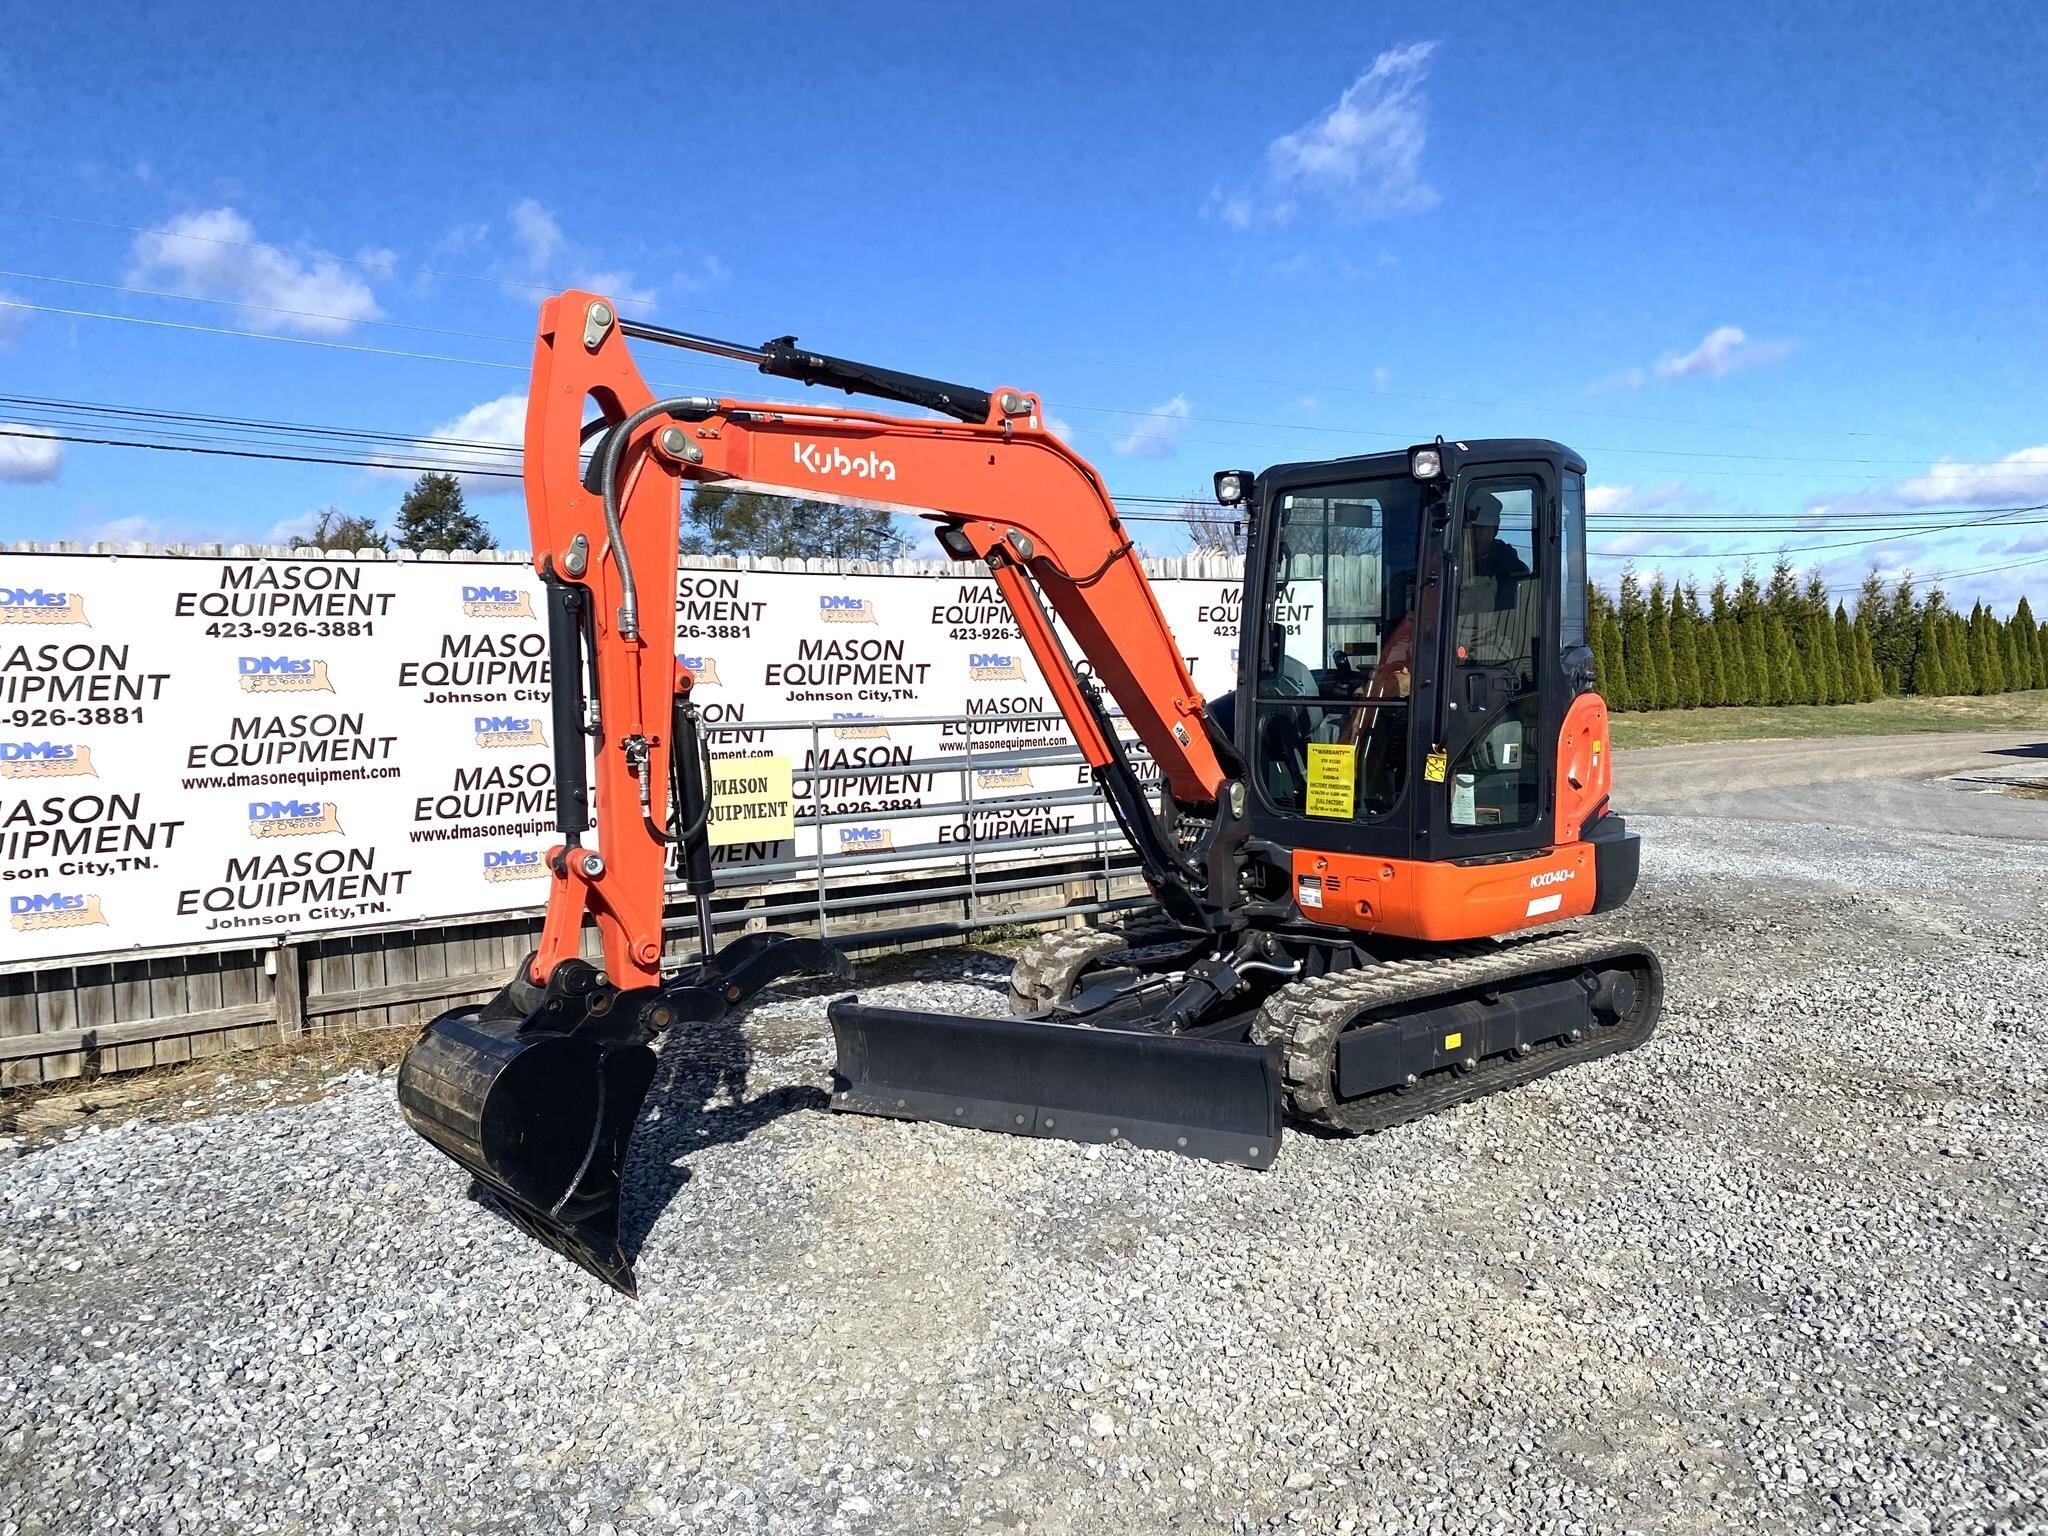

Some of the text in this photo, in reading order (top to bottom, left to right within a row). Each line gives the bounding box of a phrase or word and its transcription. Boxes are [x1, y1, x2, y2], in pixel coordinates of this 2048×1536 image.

[793, 441, 896, 481] Kubota
[220, 566, 360, 590] MASON
[679, 577, 739, 599] SON
[175, 593, 396, 617] EQUIPMENT
[958, 586, 1006, 604] MAS
[676, 601, 767, 622] PMENT
[205, 621, 373, 638] 423-926-3881
[677, 625, 751, 638] 26-3881
[949, 628, 1023, 640] 423-926-3
[440, 633, 550, 658] MASO
[798, 639, 905, 661] MASON
[0, 645, 129, 672] ASON
[399, 660, 552, 687] EQUIPME
[765, 664, 931, 686] EQUIPMENT
[0, 674, 171, 703] IPMENT
[423, 692, 507, 704] Johnson
[785, 690, 853, 702] Johnson
[0, 707, 143, 727] -926-3881
[966, 696, 1043, 715] MASON
[230, 713, 363, 740] MASON
[187, 737, 397, 769] EQUIPMENT
[939, 737, 1067, 752] www.masonequipment.com
[805, 746, 913, 772] MASON
[182, 765, 401, 790] www.dmasonequipment.com
[453, 763, 556, 791] MASO
[713, 777, 768, 796] MASON
[793, 773, 934, 800] QUIPMENT
[0, 793, 140, 828] ASON
[415, 789, 597, 821] EQUIPME
[706, 801, 788, 825] QUIPMENT
[0, 821, 185, 860] IPMENT
[938, 815, 1075, 844] EQUIPMENT
[225, 847, 375, 883] MASON
[176, 870, 412, 916] EQUIPMENT
[205, 912, 301, 931] Johnson
